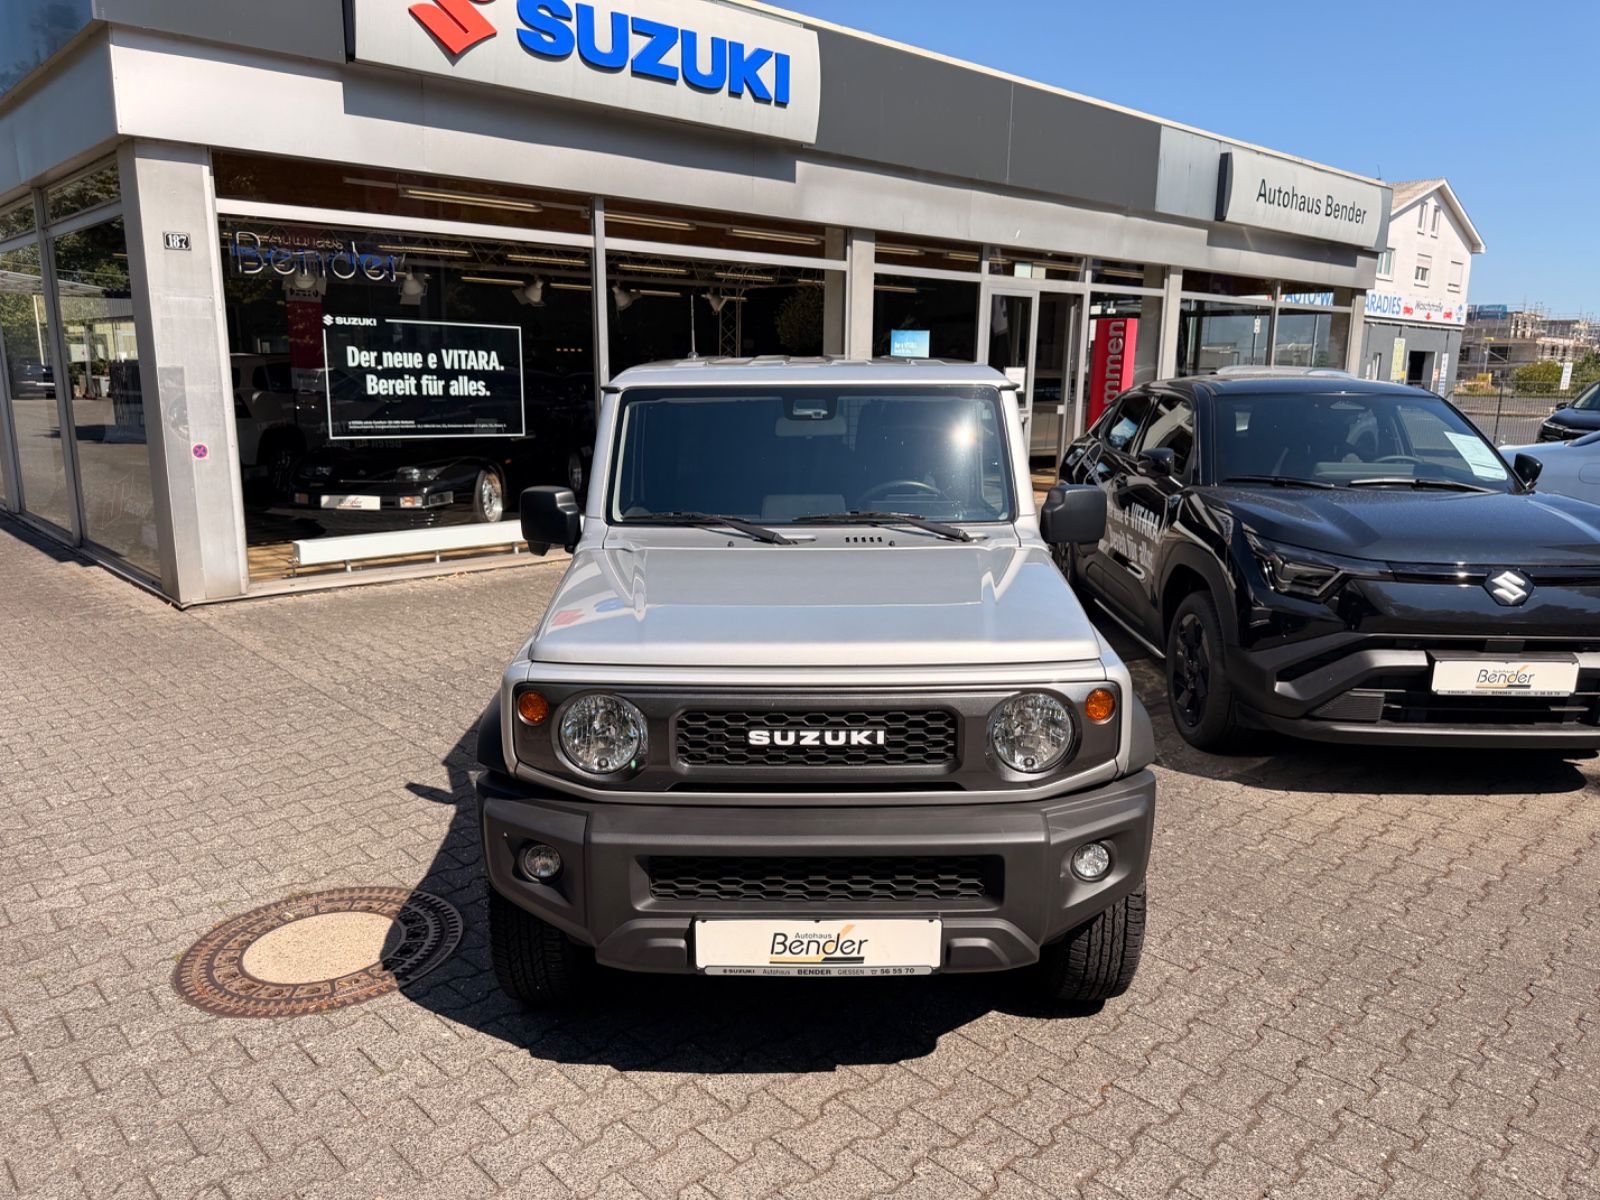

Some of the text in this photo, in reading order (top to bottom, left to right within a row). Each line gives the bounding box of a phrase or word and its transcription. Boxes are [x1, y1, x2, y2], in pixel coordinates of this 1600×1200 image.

[516, 0, 790, 104] SUZUKI
[1256, 179, 1367, 224] Autohaus Bender
[168, 235, 188, 249] 187
[335, 316, 377, 326] SUZUKI
[346, 346, 505, 371] Der neue e VITARA.
[366, 374, 491, 397] Bereit für alles.
[1477, 668, 1535, 684] Bender
[748, 730, 885, 746] SUZUKI
[770, 931, 869, 956] Bender
[794, 932, 832, 940] Autohaus
